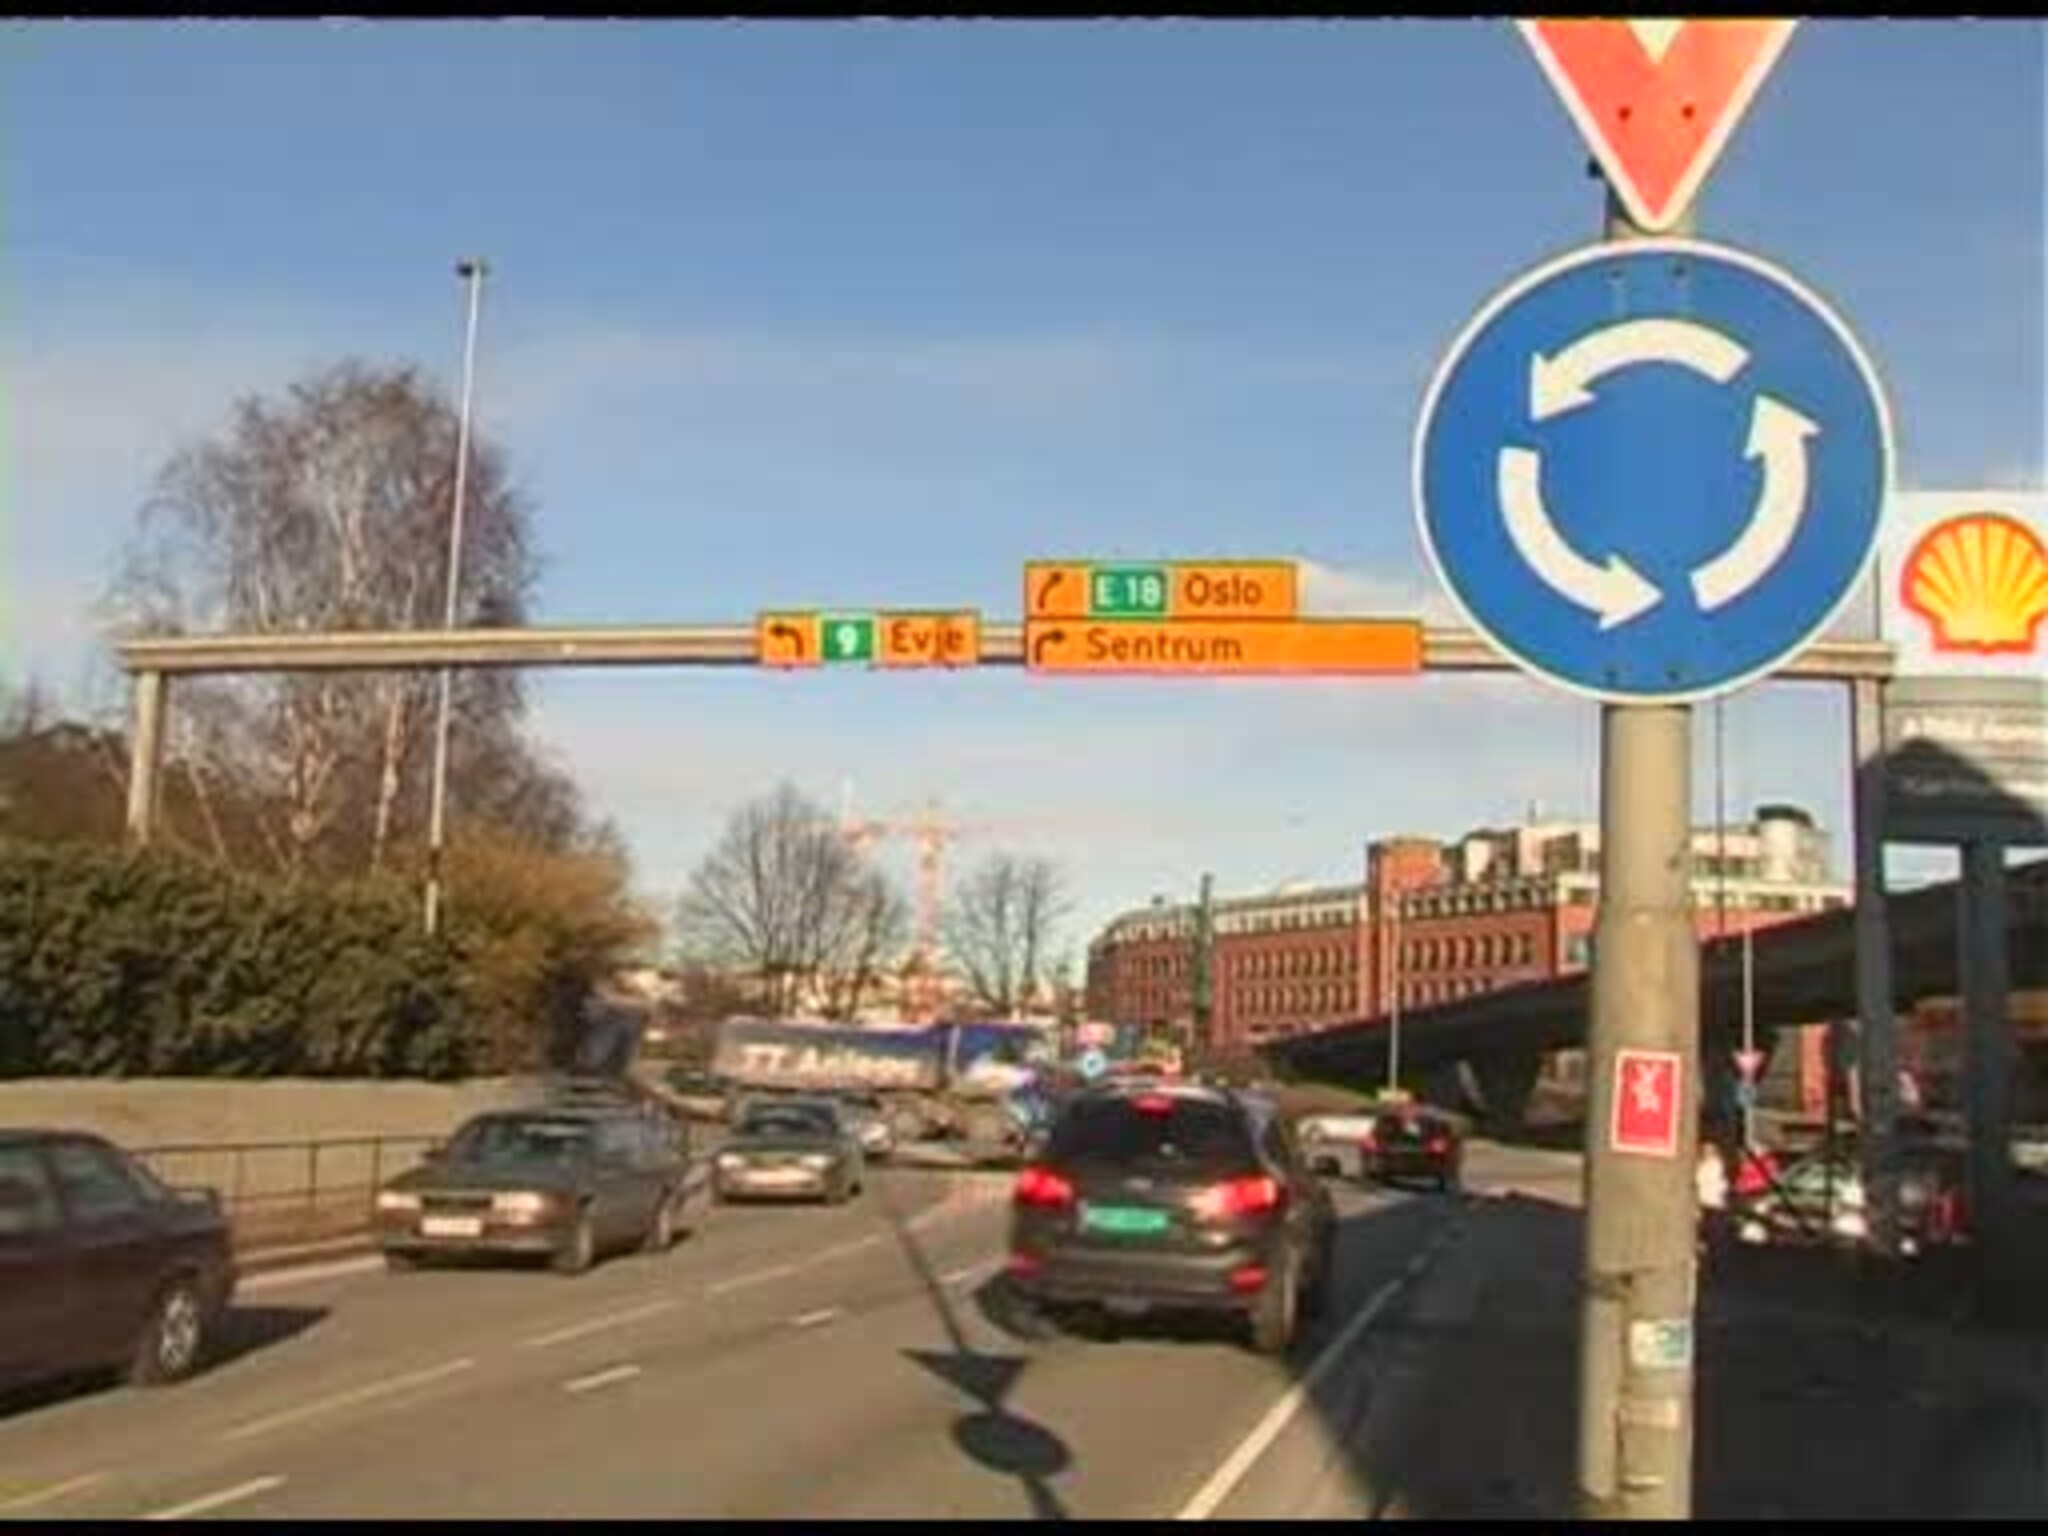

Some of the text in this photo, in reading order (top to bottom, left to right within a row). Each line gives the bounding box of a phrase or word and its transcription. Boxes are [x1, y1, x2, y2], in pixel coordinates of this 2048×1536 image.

[1184, 572, 1264, 607] Oslo
[836, 618, 965, 661] 9 Evje
[1086, 627, 1244, 662] Sentrum
